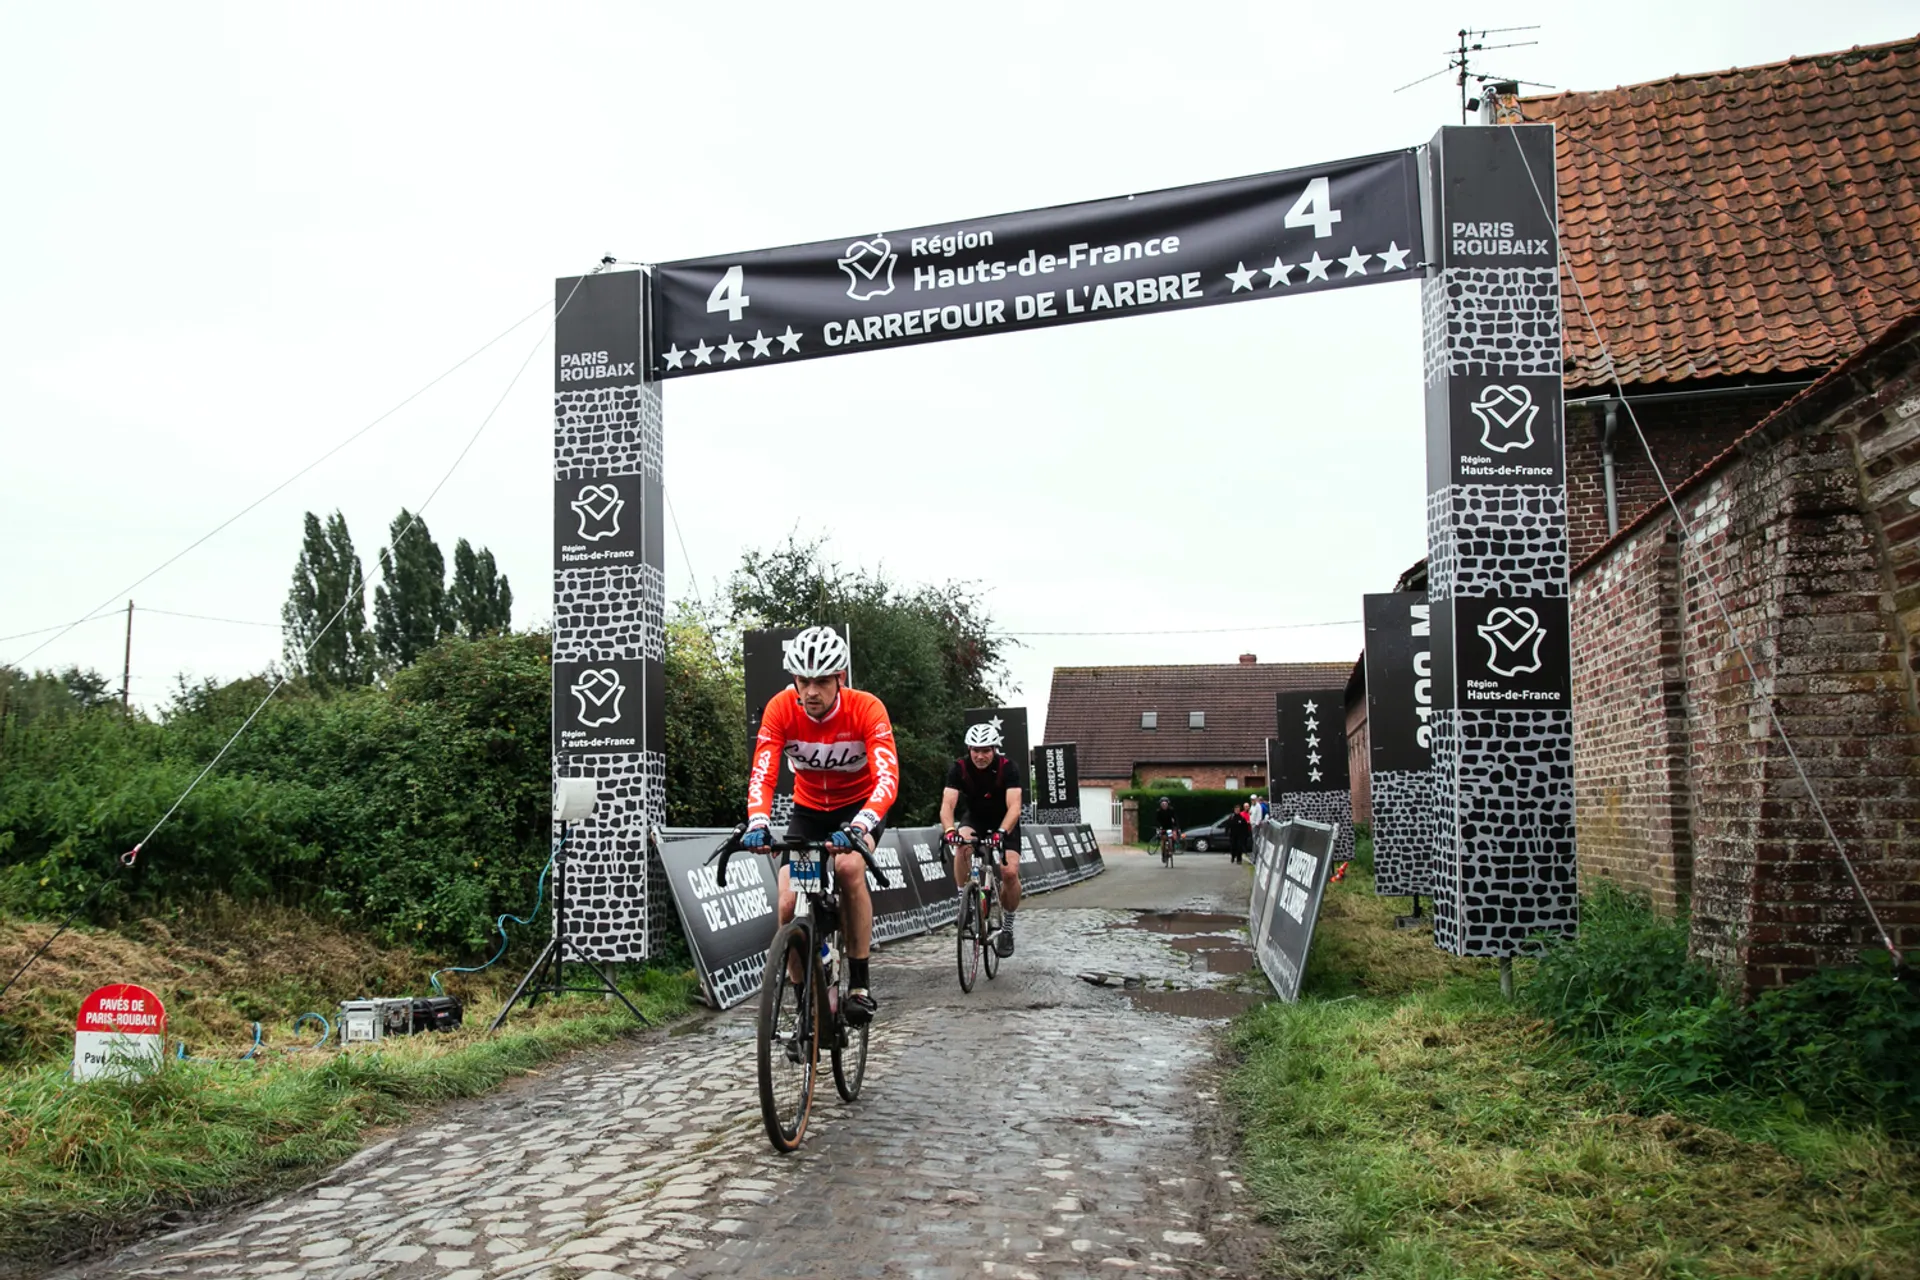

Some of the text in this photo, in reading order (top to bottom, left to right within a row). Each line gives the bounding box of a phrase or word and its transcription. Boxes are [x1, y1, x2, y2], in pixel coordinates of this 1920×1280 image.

[1284, 177, 1342, 238] 4
[1452, 222, 1514, 238] PARIS
[911, 231, 994, 257] Région
[1453, 240, 1549, 255] ROUBAIX
[913, 235, 1181, 291] Hauts-de-France
[706, 265, 750, 322] 4
[823, 271, 1203, 346] CARREFOUR DE L'ARBRE
[560, 350, 609, 367] PARIS
[560, 362, 635, 382] ROUBAIX
[1460, 455, 1492, 465] Région
[1461, 465, 1553, 475] Hauts-de-France
[562, 545, 586, 553] Région
[562, 550, 635, 562] Hauts-de-France
[1467, 680, 1498, 690] Région
[1467, 690, 1560, 700] Hauts-de-France
[561, 730, 586, 739] Région
[1046, 749, 1057, 804] CARREFOUR
[1055, 748, 1066, 800] DE L'ARBRE
[793, 862, 816, 872] 3321
[701, 886, 773, 932] DE L'ARBRE
[100, 996, 144, 1011] PAVÉS DE
[85, 1011, 157, 1026] PARIS-ROUBAIX
